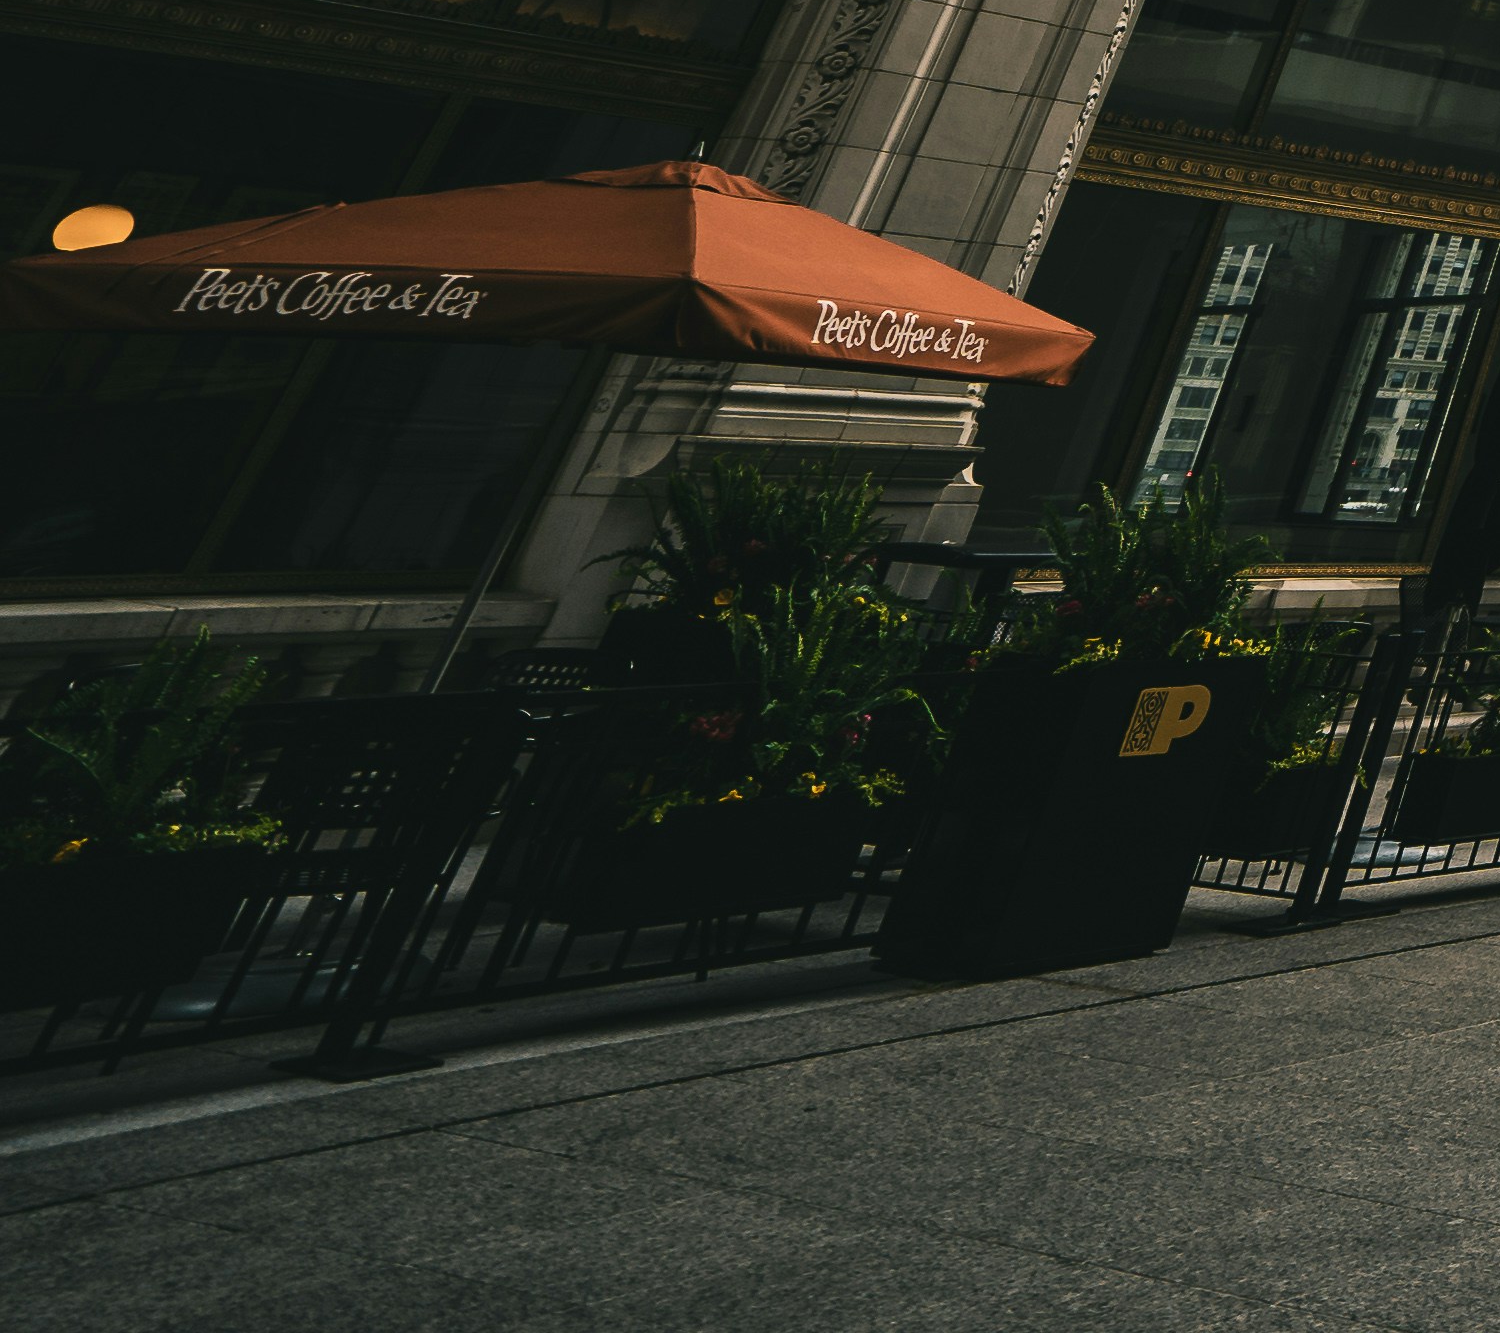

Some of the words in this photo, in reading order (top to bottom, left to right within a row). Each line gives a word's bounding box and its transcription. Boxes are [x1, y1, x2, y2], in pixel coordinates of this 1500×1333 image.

[173, 268, 281, 315] Peet's
[275, 271, 373, 321] Coffee
[387, 283, 428, 310] &
[416, 273, 480, 319] Tea
[811, 299, 872, 349] Peet's
[870, 309, 934, 359] Coffee
[934, 327, 956, 352] &
[951, 318, 985, 364] Tea
